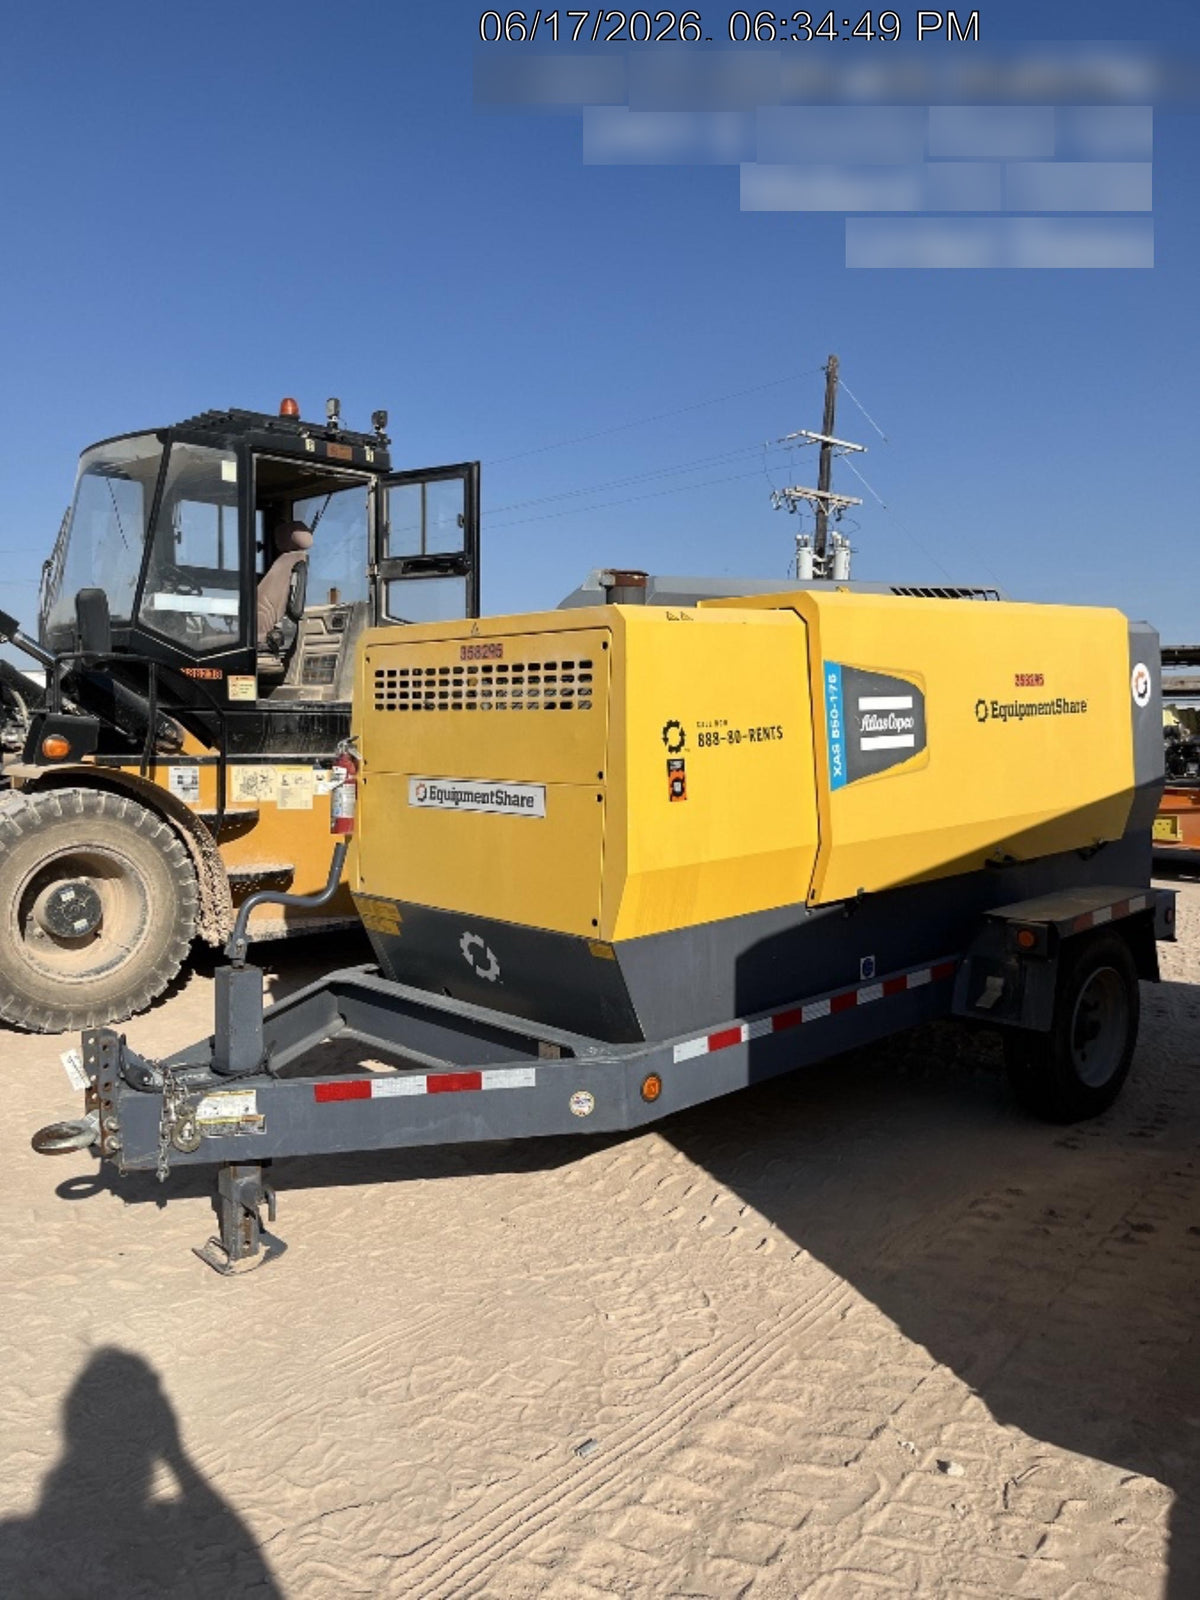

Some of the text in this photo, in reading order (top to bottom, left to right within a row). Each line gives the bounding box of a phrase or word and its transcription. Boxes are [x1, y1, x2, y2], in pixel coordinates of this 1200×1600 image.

[990, 698, 1087, 722] EquipmentShare
[697, 724, 783, 747] 888-80-RENTS
[429, 785, 535, 808] EquipmentShare
